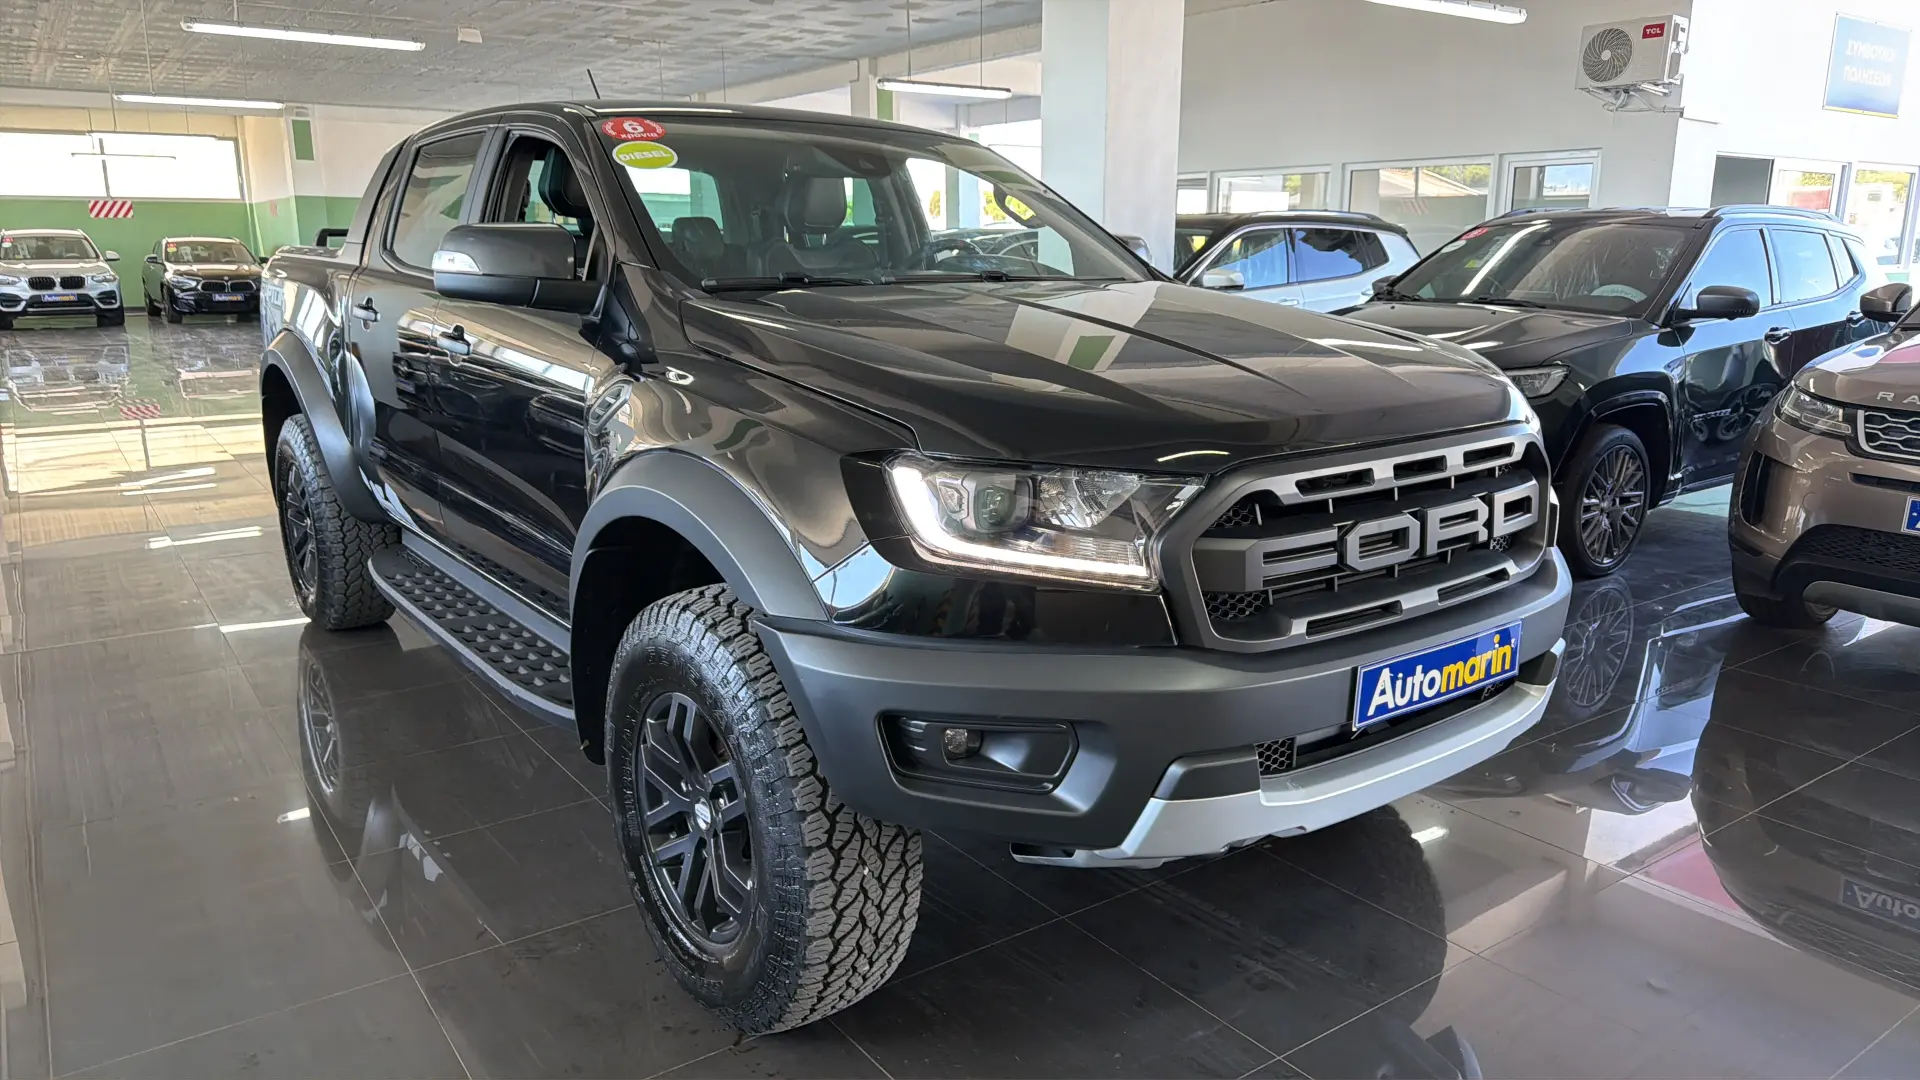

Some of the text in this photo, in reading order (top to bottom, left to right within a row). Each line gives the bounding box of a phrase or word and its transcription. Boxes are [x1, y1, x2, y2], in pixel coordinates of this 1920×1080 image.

[1645, 27, 1661, 35] TCL
[623, 121, 644, 133] 6
[619, 151, 670, 161] DIESEL
[1246, 482, 1540, 592] FORD
[1367, 634, 1511, 716] Automarin
